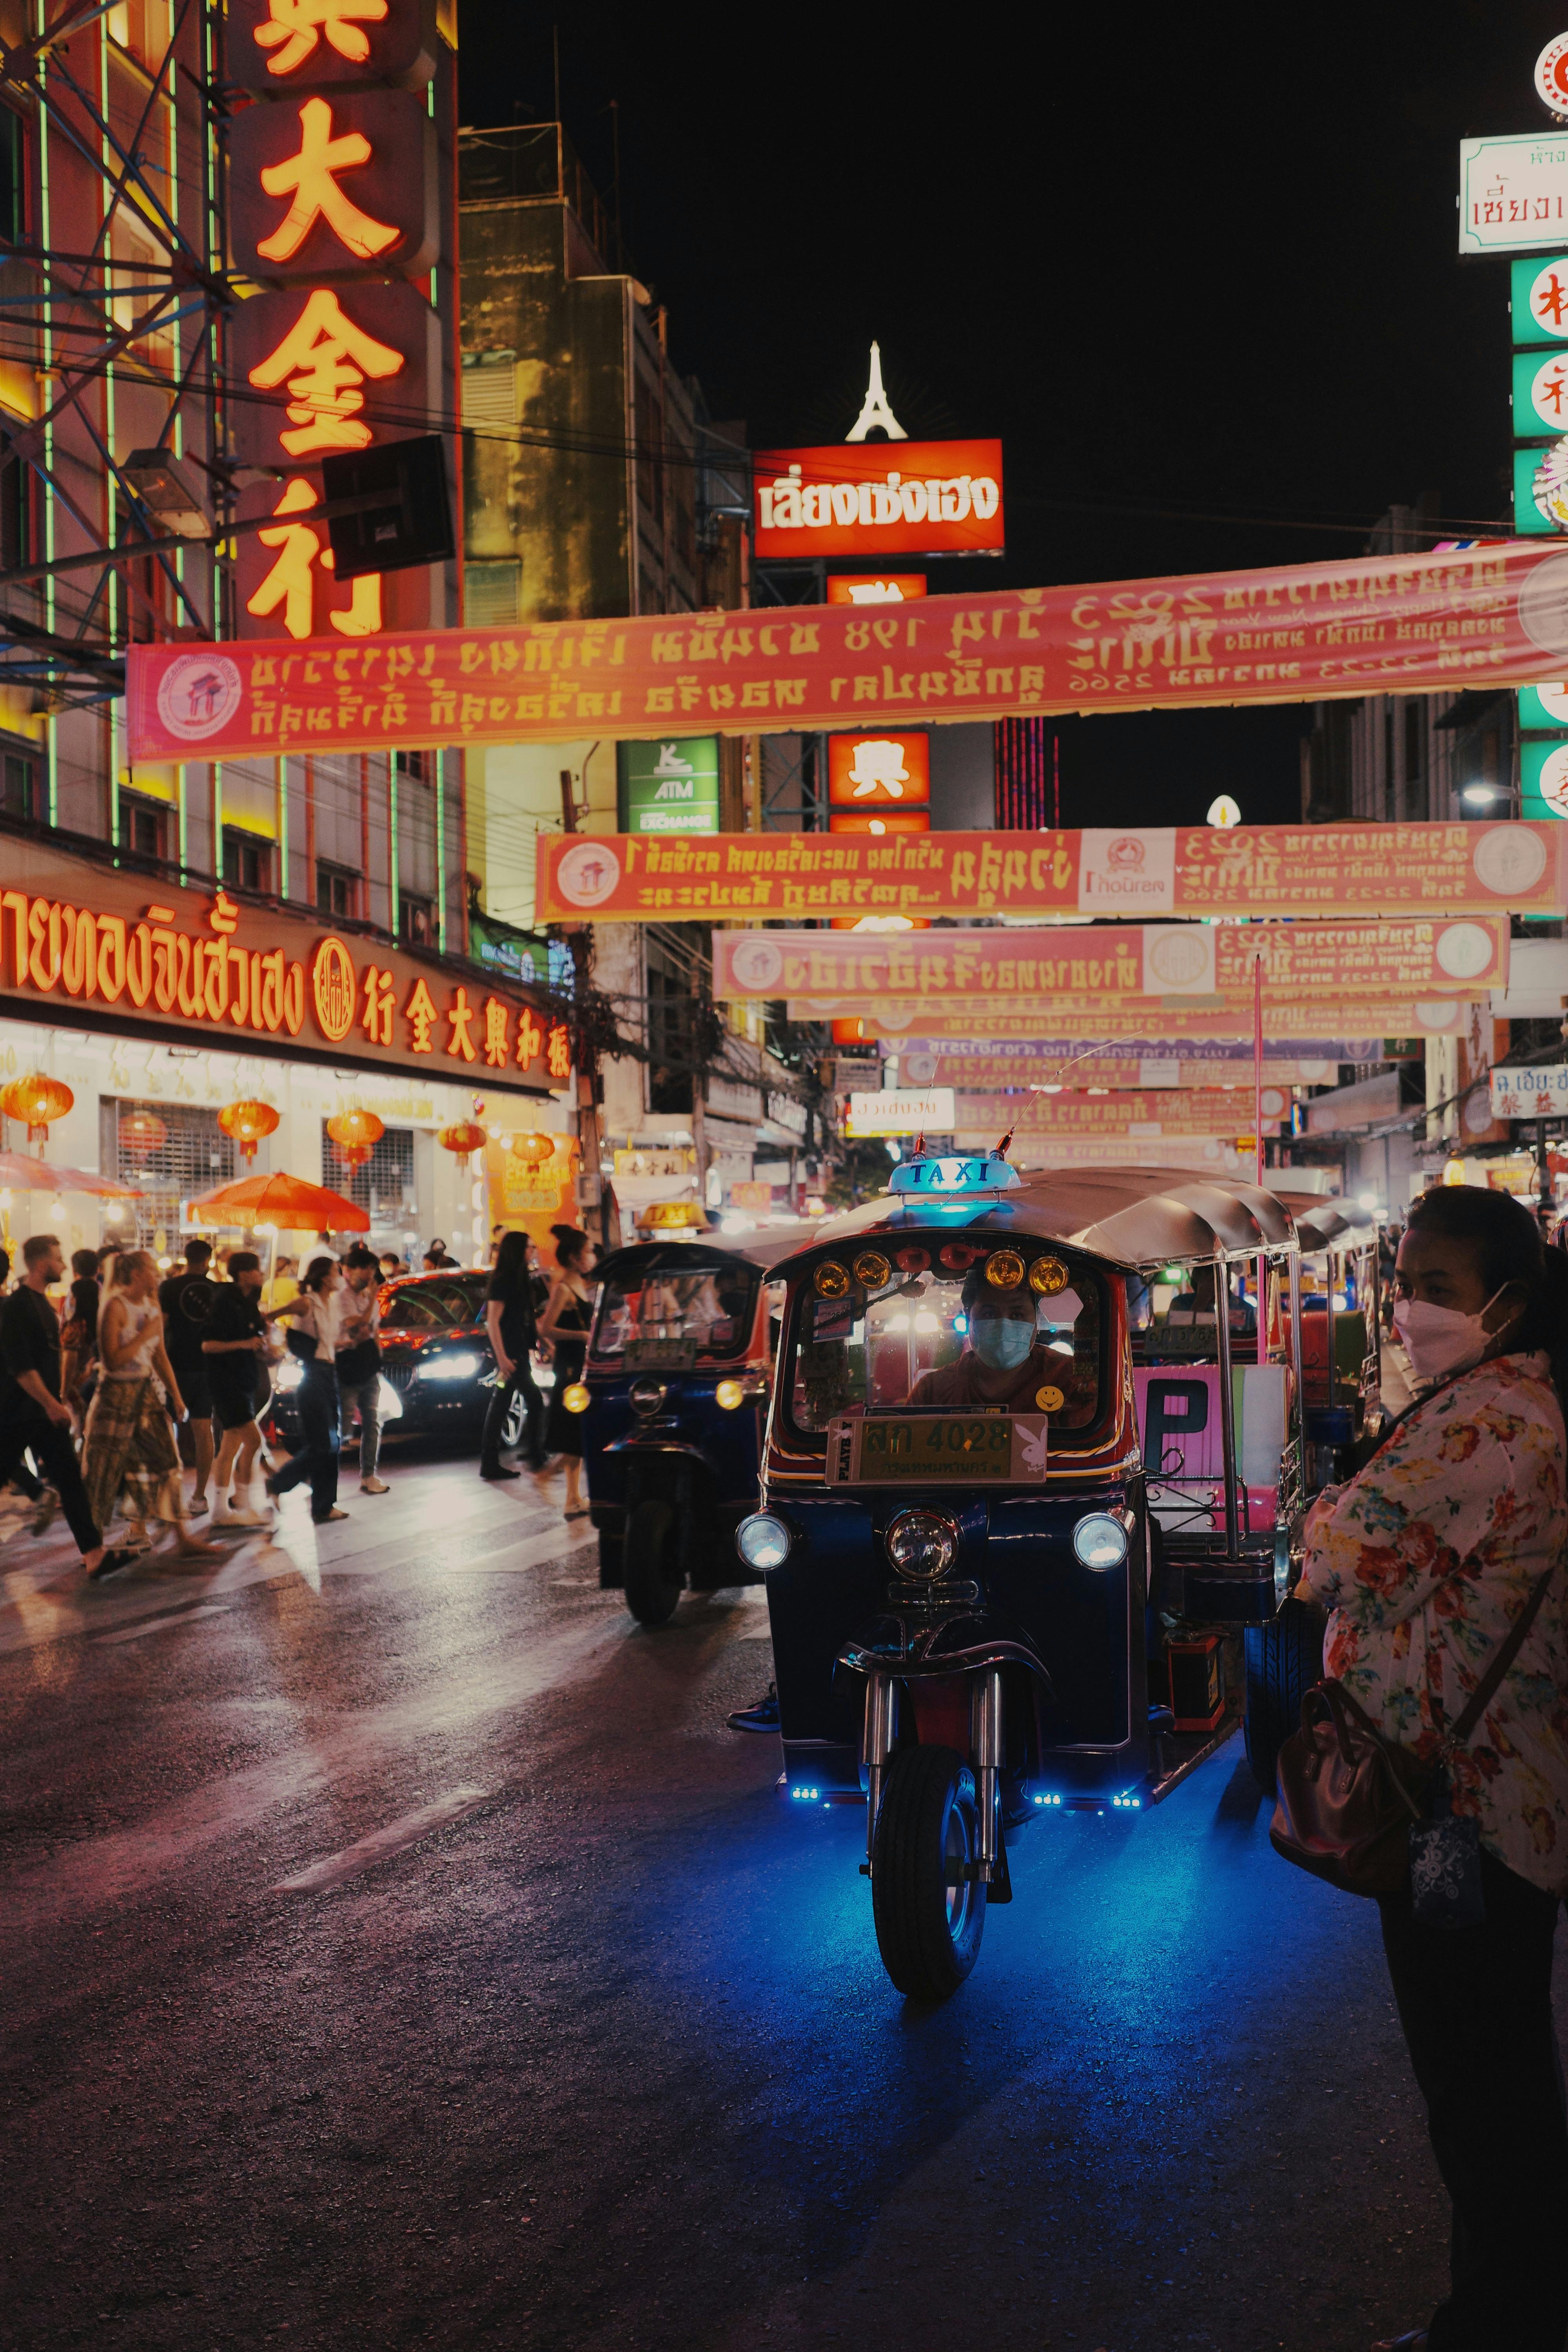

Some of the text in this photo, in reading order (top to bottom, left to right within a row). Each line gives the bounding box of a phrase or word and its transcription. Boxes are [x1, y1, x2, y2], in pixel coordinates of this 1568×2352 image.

[654, 780, 693, 799] ATM
[640, 815, 711, 830] EXCHANGE
[0, 891, 305, 1036] ายทองจินฮั้วเฮง
[910, 1162, 989, 1183] TAXI
[506, 1191, 558, 1208] 2023
[649, 1205, 691, 1222] TAXI
[926, 1421, 1007, 1452] 4028
[1145, 1378, 1209, 1476] P
